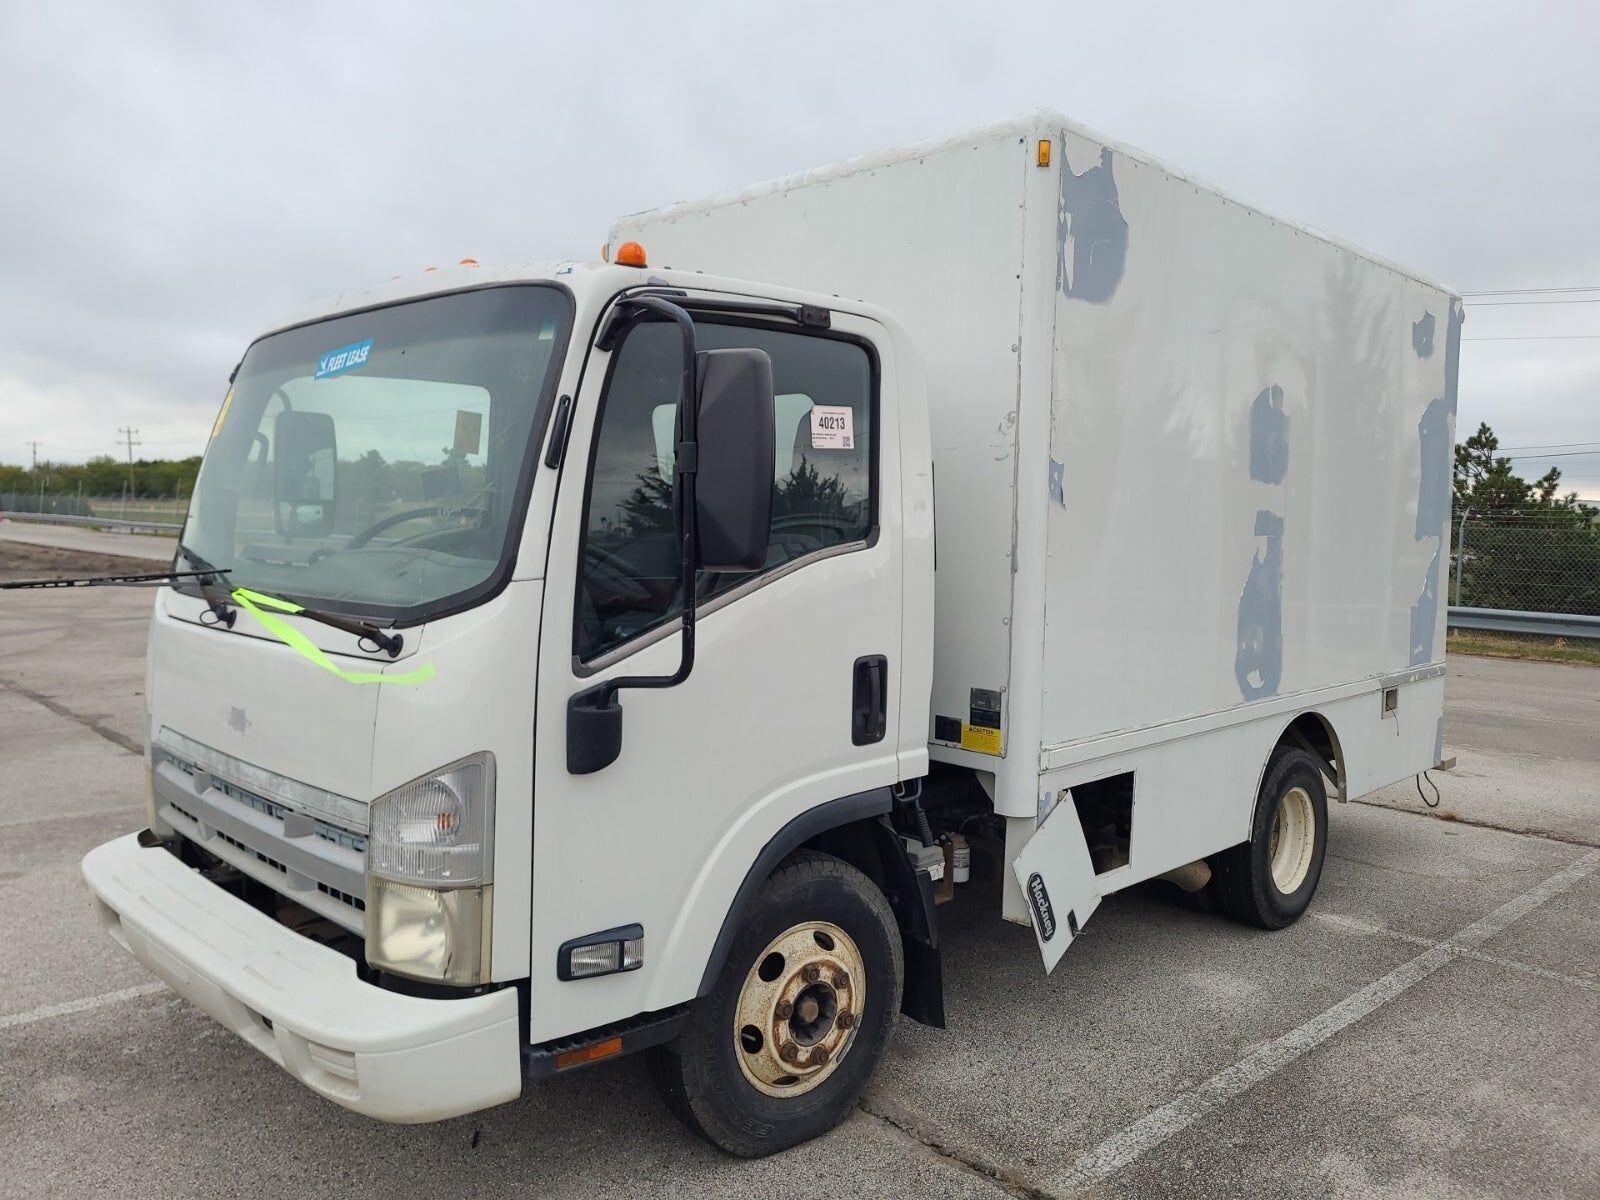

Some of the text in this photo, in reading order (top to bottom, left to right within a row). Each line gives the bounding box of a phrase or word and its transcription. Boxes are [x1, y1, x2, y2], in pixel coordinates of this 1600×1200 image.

[326, 345, 370, 373] FLEET LEASE
[818, 416, 846, 430] 40213
[1030, 877, 1054, 937] Hackney
